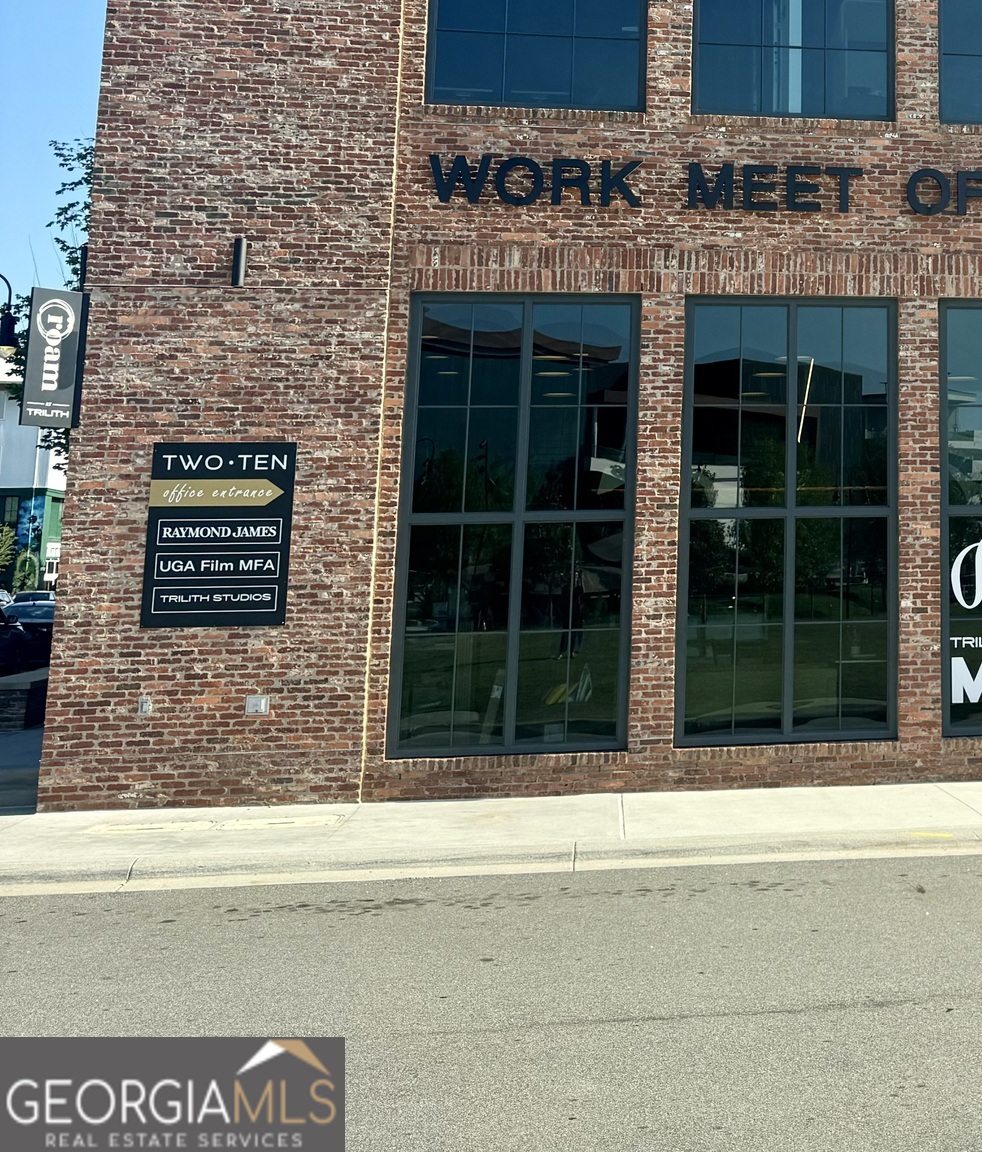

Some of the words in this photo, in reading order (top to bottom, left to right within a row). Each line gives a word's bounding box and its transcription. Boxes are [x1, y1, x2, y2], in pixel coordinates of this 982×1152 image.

[429, 154, 642, 208] WORK
[687, 162, 863, 214] MEET
[41, 314, 64, 392] roam
[26, 407, 70, 419] TRILITH
[162, 483, 205, 503] office
[211, 486, 273, 498] entrance
[161, 527, 231, 538] RAYMOND
[232, 526, 277, 537] JAMES
[159, 560, 196, 572] UGA
[200, 559, 234, 571] Film
[239, 559, 276, 571] MFA
[160, 594, 210, 603] TRILITH
[212, 593, 272, 602] STUDIOS
